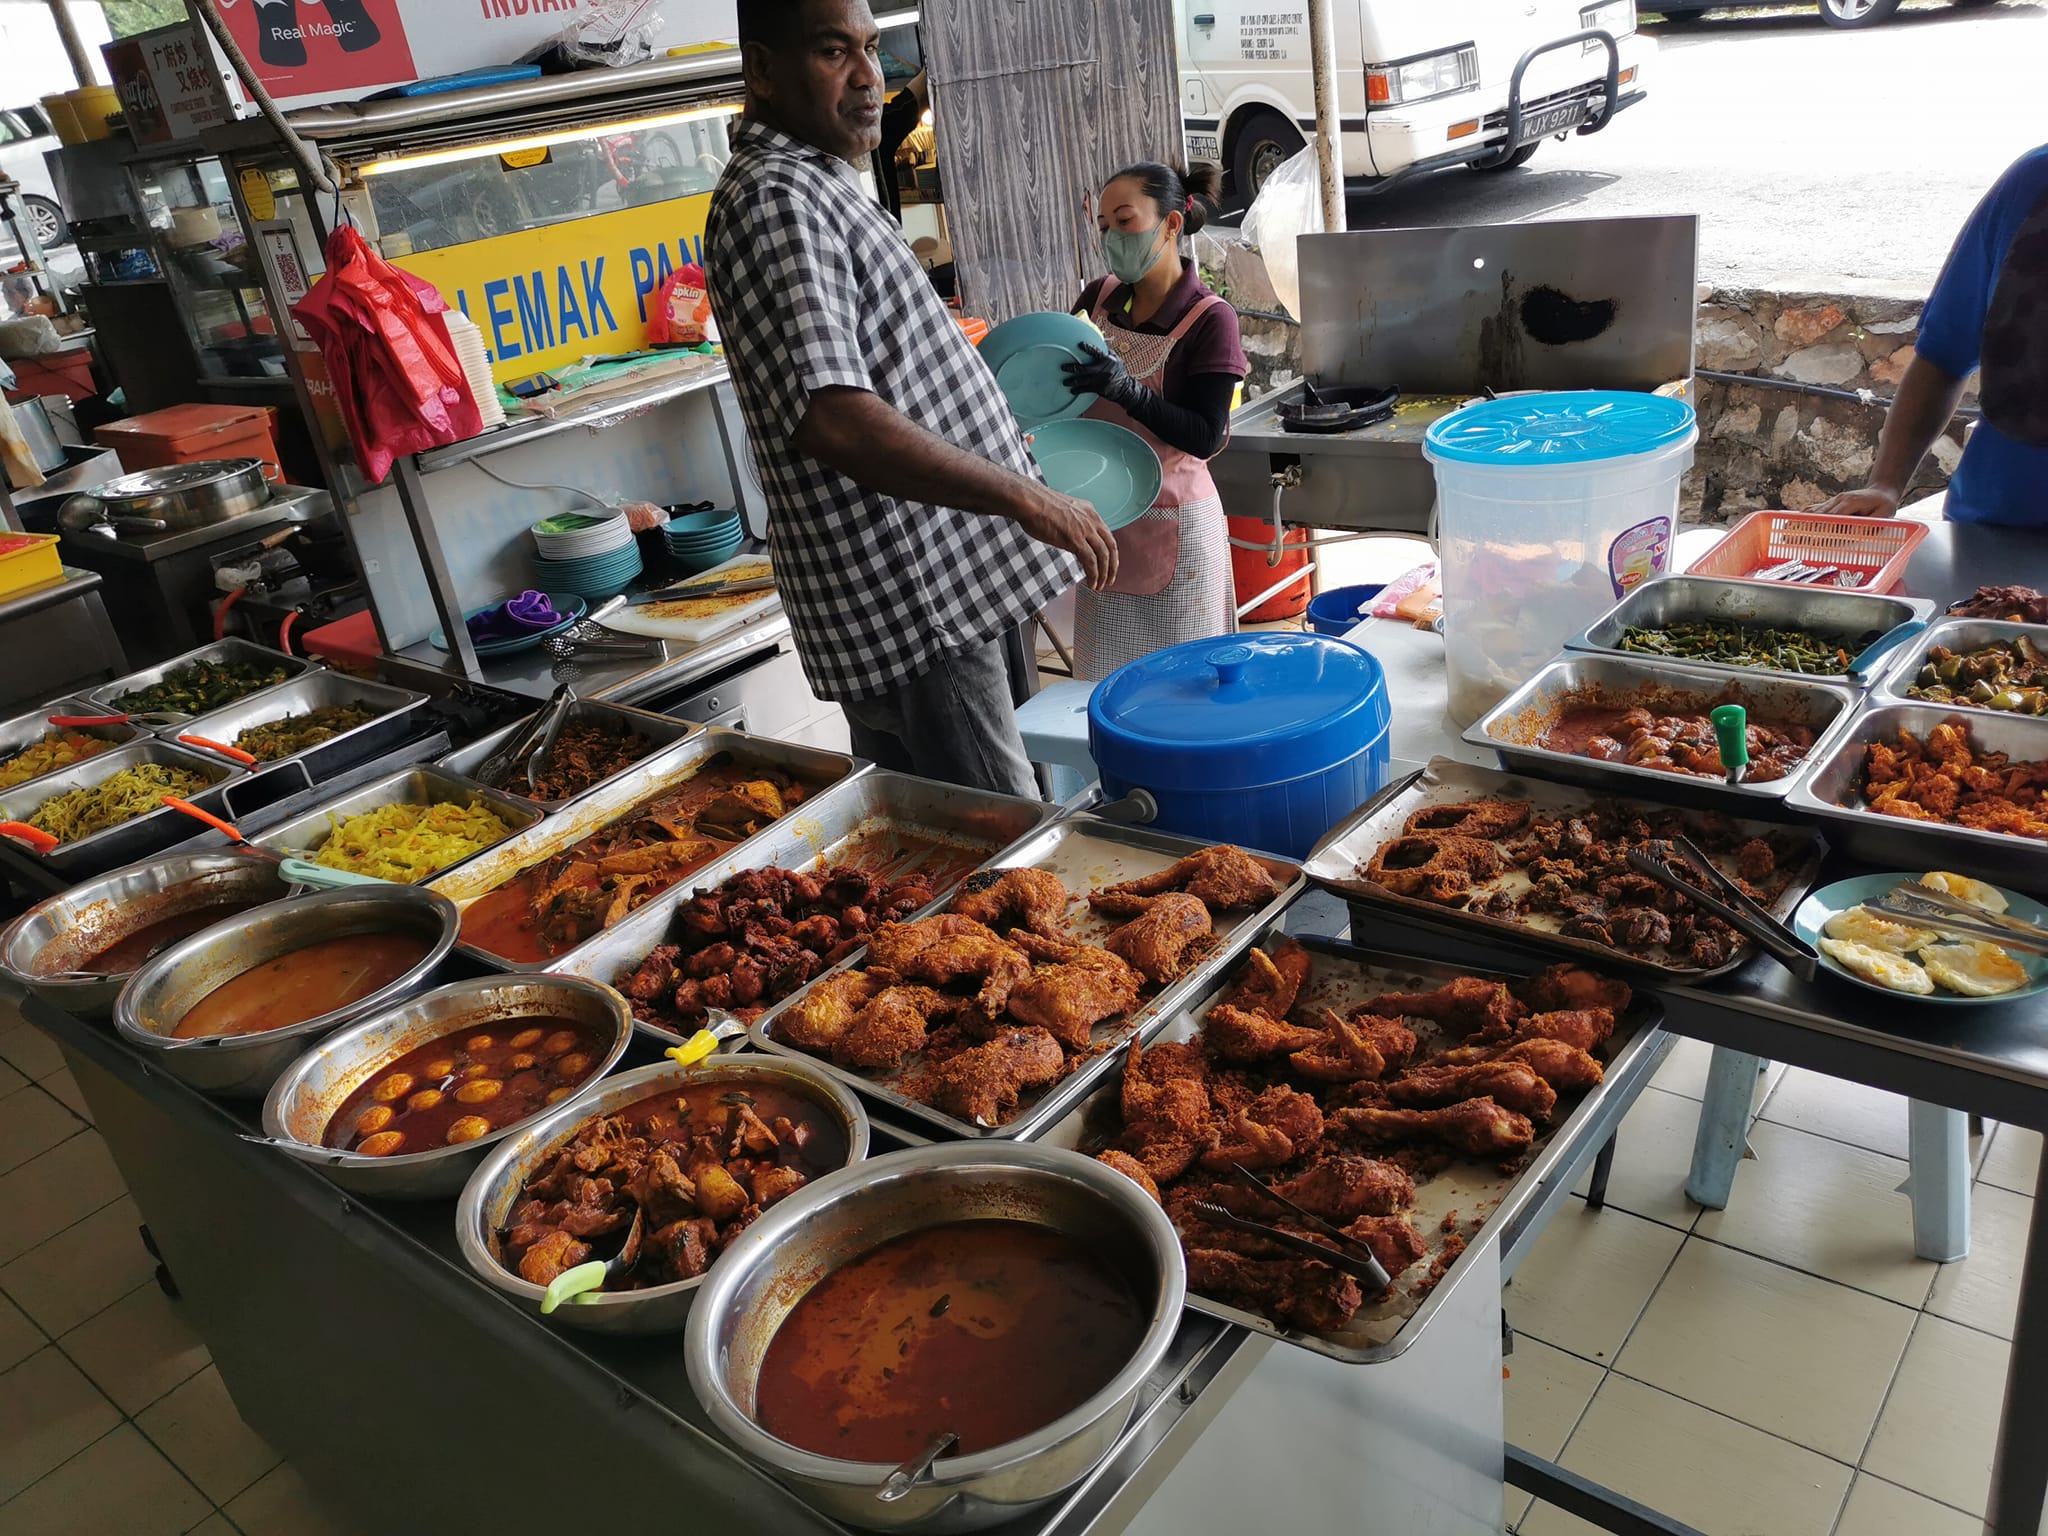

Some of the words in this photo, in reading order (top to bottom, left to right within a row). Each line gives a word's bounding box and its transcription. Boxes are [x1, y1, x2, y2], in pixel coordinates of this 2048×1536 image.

[271, 24, 307, 41] Real
[1523, 114, 1549, 138] WJX
[1550, 105, 1579, 128] 9211
